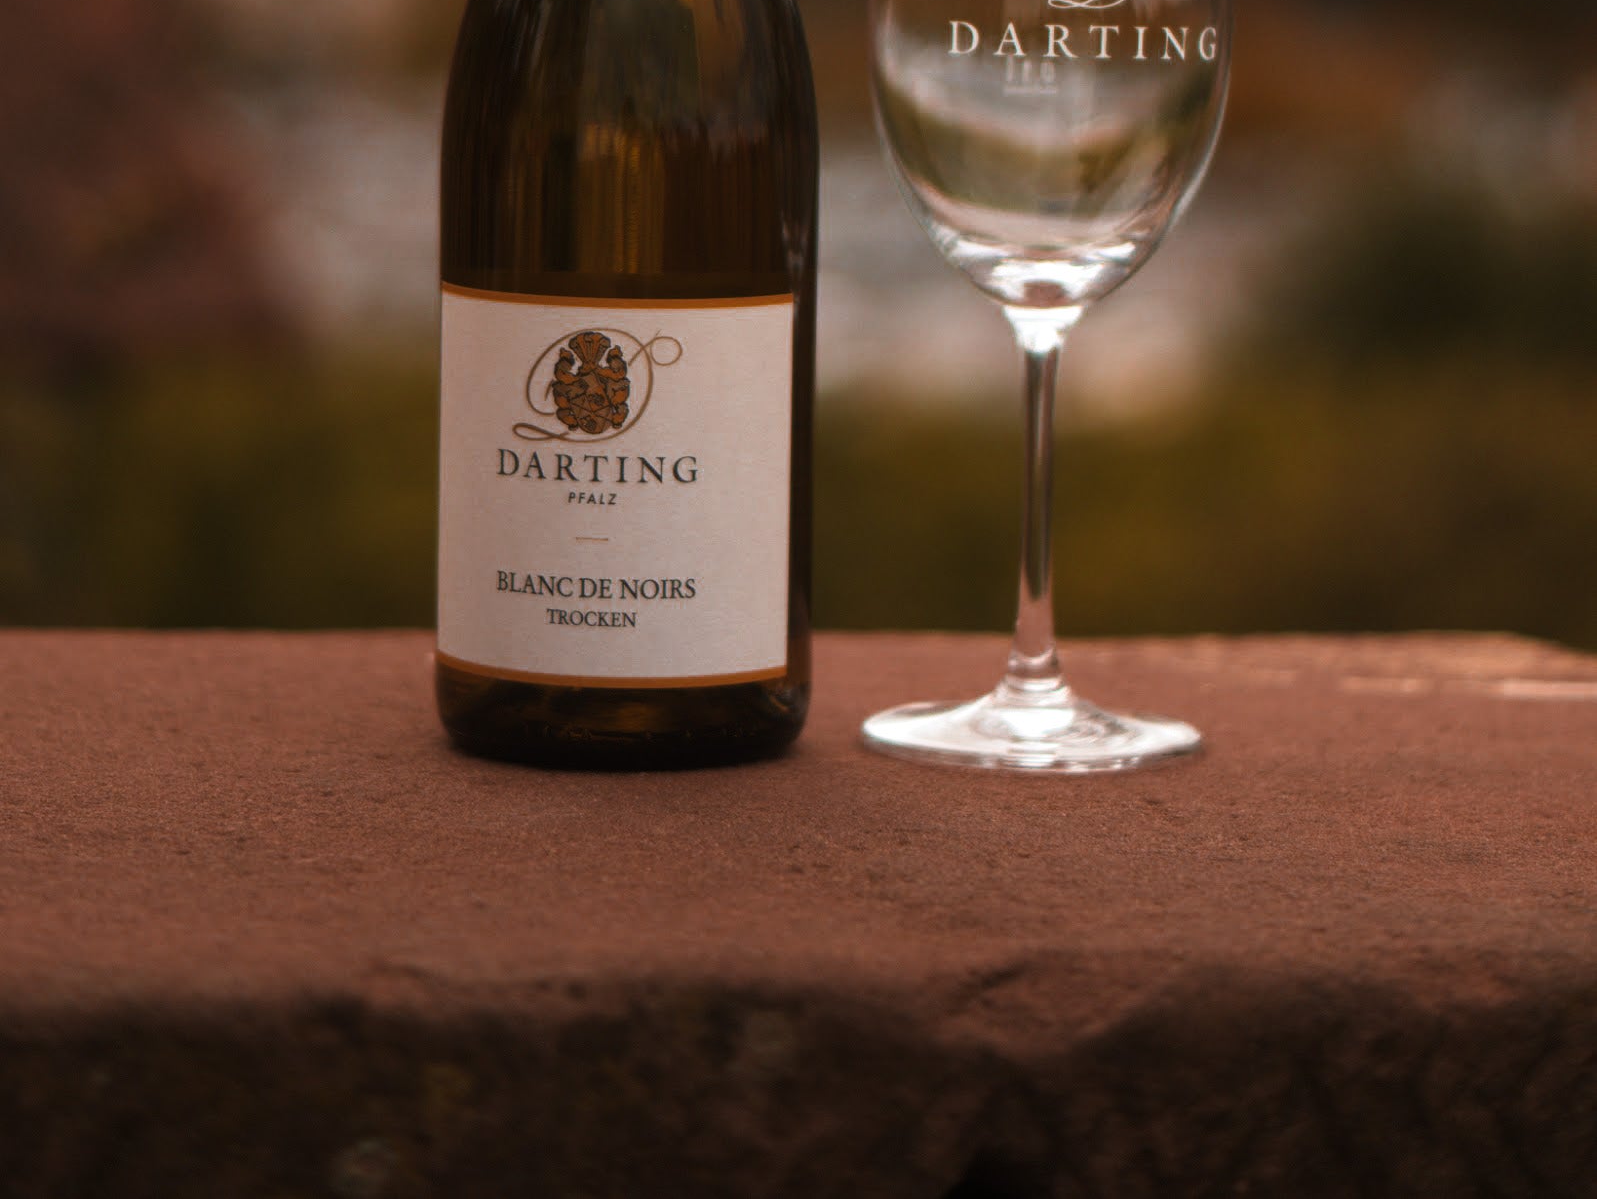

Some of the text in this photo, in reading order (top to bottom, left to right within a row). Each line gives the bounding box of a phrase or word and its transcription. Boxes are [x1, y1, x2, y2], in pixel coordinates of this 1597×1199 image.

[948, 20, 1217, 61] DARTING
[496, 448, 698, 483] DARTING
[568, 491, 617, 505] PFALZ
[496, 570, 697, 600] BLANC DE NOIRS
[546, 608, 637, 628] TROCKEN
